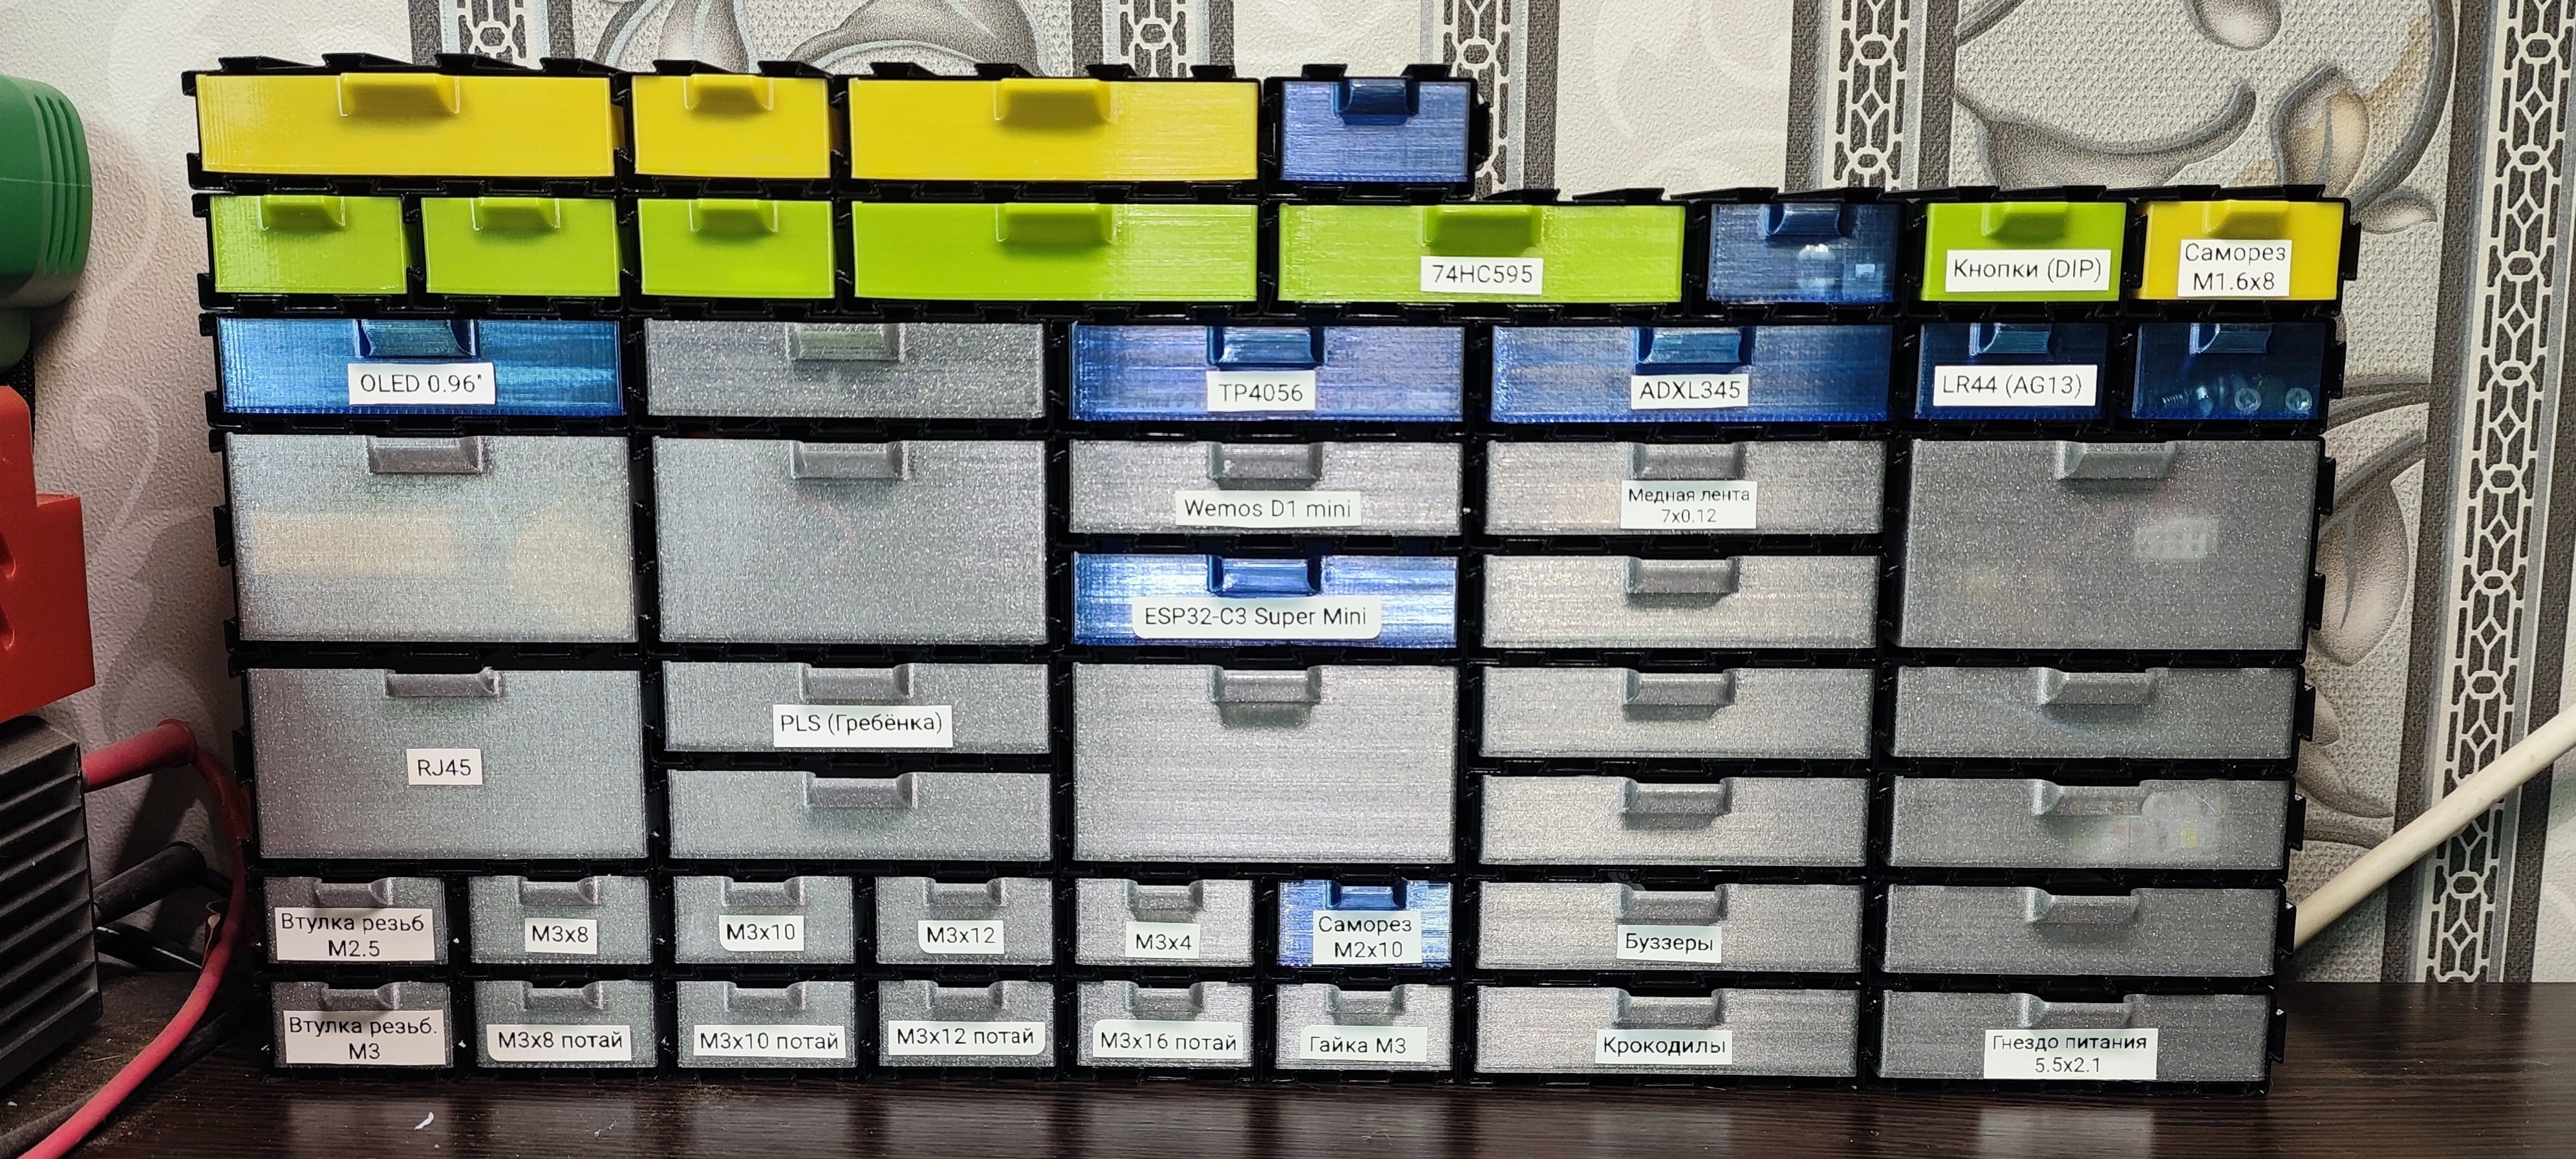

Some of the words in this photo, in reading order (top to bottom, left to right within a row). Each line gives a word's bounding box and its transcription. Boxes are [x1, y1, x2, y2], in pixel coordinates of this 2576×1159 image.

[2185, 243, 2286, 265] Саморез
[1432, 265, 1532, 283] 74HC595
[1954, 259, 2038, 277] Кнопки
[2047, 257, 2101, 283] (DIP)
[360, 374, 420, 393] OLED
[1639, 380, 1740, 400] ADXL345
[1943, 375, 1998, 394] LR44
[2006, 374, 2082, 399] (AG13)
[1219, 384, 1303, 402] TP4056
[1629, 488, 1695, 504] Медная
[1700, 490, 1750, 501] лента
[1185, 499, 1263, 517] Wemos
[1271, 499, 1294, 517] D1
[1306, 500, 1350, 517] mini
[1661, 508, 1717, 523] 7x0.12
[1145, 607, 1247, 625] ESP32-C3
[1254, 607, 1316, 629] Super
[1324, 607, 1366, 625] Mini
[780, 714, 821, 732] PLS
[828, 711, 942, 736] (Гребёнка)
[417, 759, 471, 777] RJ45
[281, 911, 356, 934] Втулка
[362, 913, 425, 935] резьб
[1318, 916, 1412, 937] Саморез
[1626, 933, 1713, 955] Буззеры
[289, 1016, 363, 1037] Втулка
[370, 1017, 438, 1038] резьб.
[974, 1027, 1034, 1045] потай
[561, 1031, 623, 1048] потай
[777, 1032, 838, 1050] потай
[1175, 1034, 1236, 1051] потай
[1311, 1036, 1368, 1053] Гайка
[1604, 1036, 1725, 1057] Крокодилы
[1993, 1035, 2059, 1052] Гнездо
[2066, 1037, 2147, 1049] питания
[2035, 1056, 2099, 1073] 5.5x2.1
